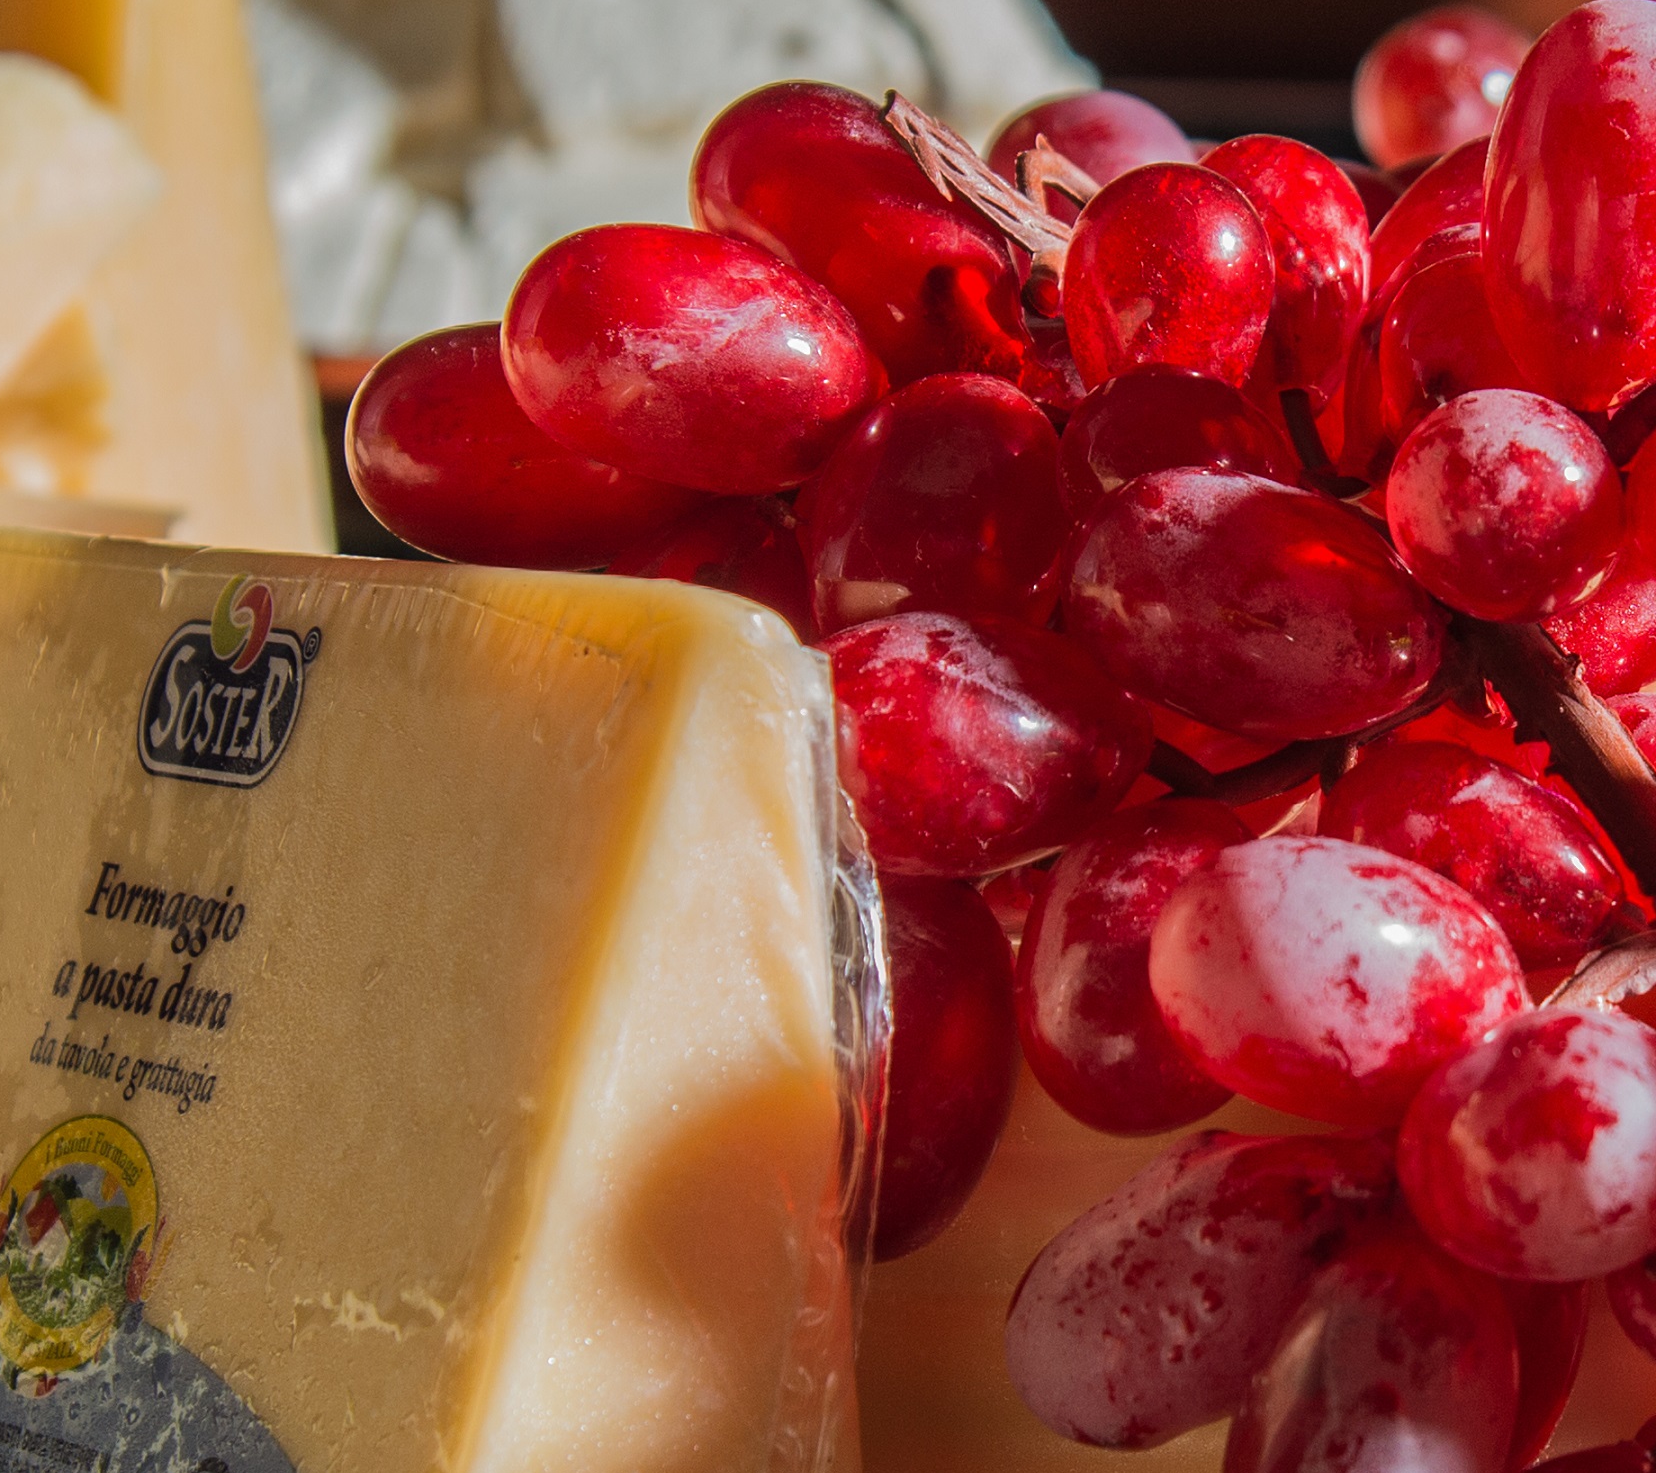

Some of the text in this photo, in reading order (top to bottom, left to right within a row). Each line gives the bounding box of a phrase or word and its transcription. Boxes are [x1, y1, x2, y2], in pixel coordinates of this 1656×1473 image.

[149, 644, 291, 763] SOSTER
[85, 861, 245, 957] Formaggio
[52, 959, 232, 1031] a pasta dura
[29, 1021, 217, 1114] da tavola e grattugia
[92, 1130, 144, 1188] Formaggi
